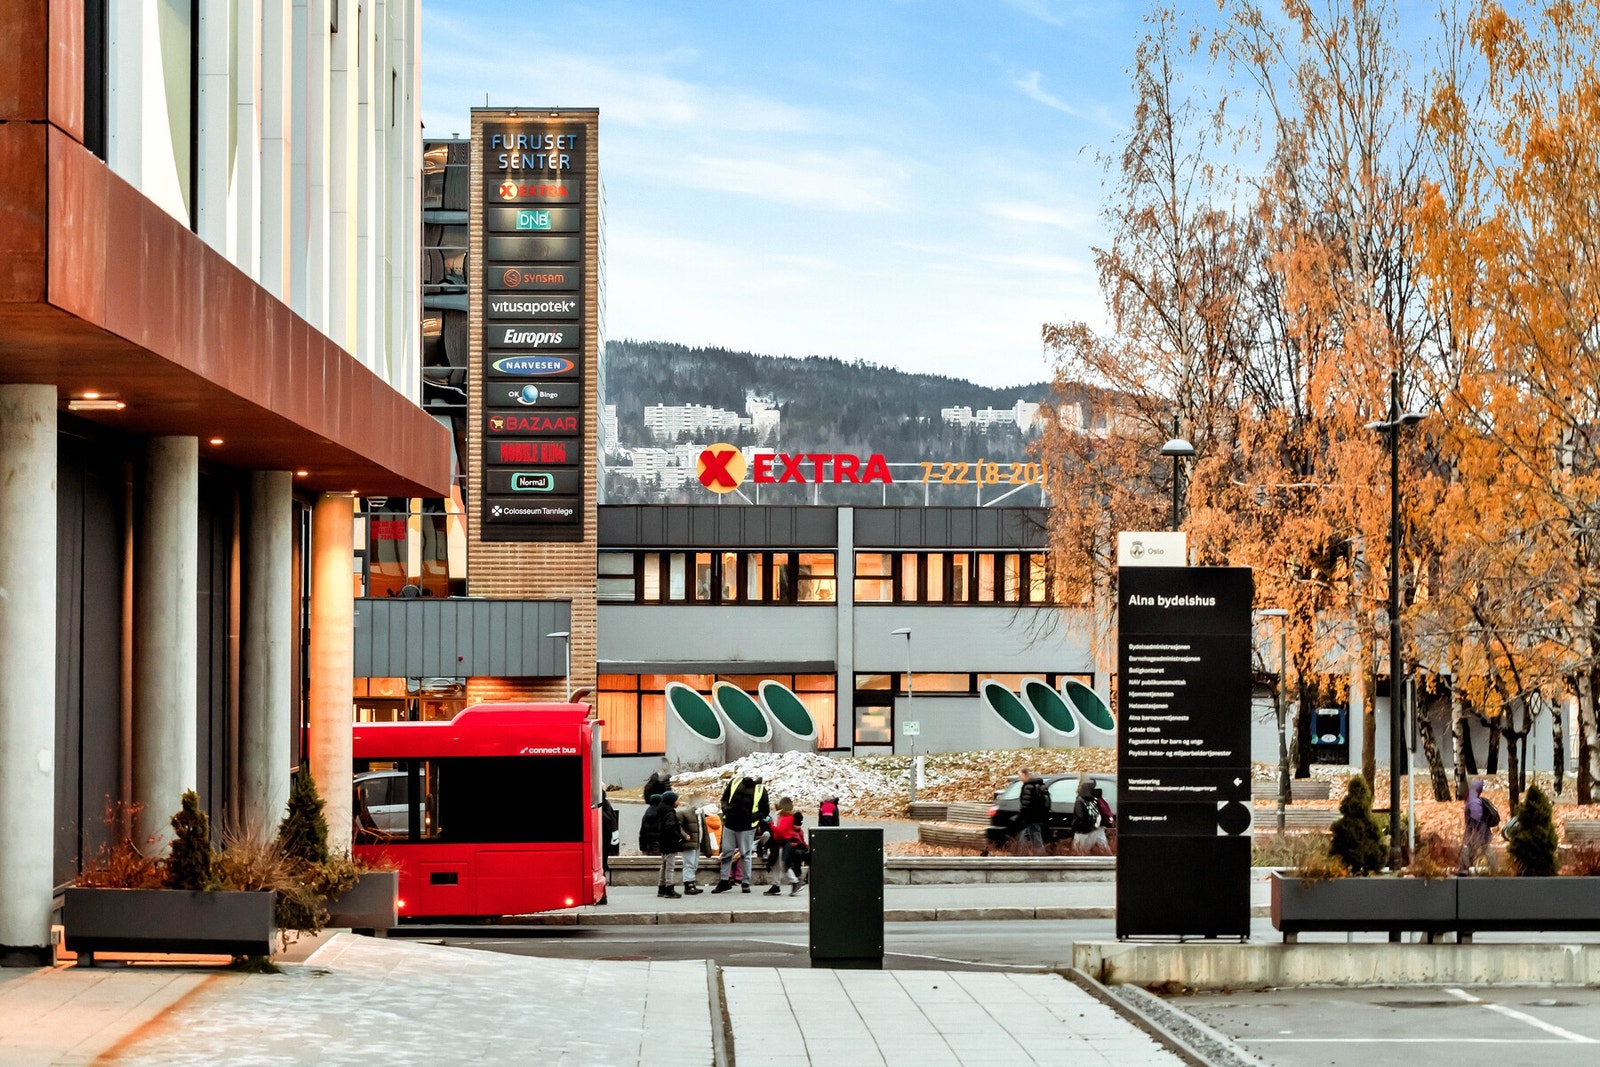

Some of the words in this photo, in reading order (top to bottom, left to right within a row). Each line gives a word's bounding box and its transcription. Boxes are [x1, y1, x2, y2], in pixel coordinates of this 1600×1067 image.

[492, 134, 576, 150] FURUSET
[498, 154, 570, 169] SENTER
[517, 184, 568, 197] EXTRA
[520, 211, 548, 229] DNB
[503, 328, 563, 347] Europris
[506, 361, 561, 369] NARVESEN
[539, 391, 558, 399] Bingo
[506, 416, 577, 431] BAZAAR
[753, 453, 893, 484] EXTRA
[920, 461, 969, 485] 7-22
[975, 457, 1048, 489] (8-20)
[519, 477, 546, 487] Normal
[503, 507, 542, 515] Colosseum
[542, 507, 573, 517] Tannlege
[1147, 547, 1164, 555] Oslo
[1128, 594, 1154, 606] Alna
[1157, 594, 1216, 608] bydelshus
